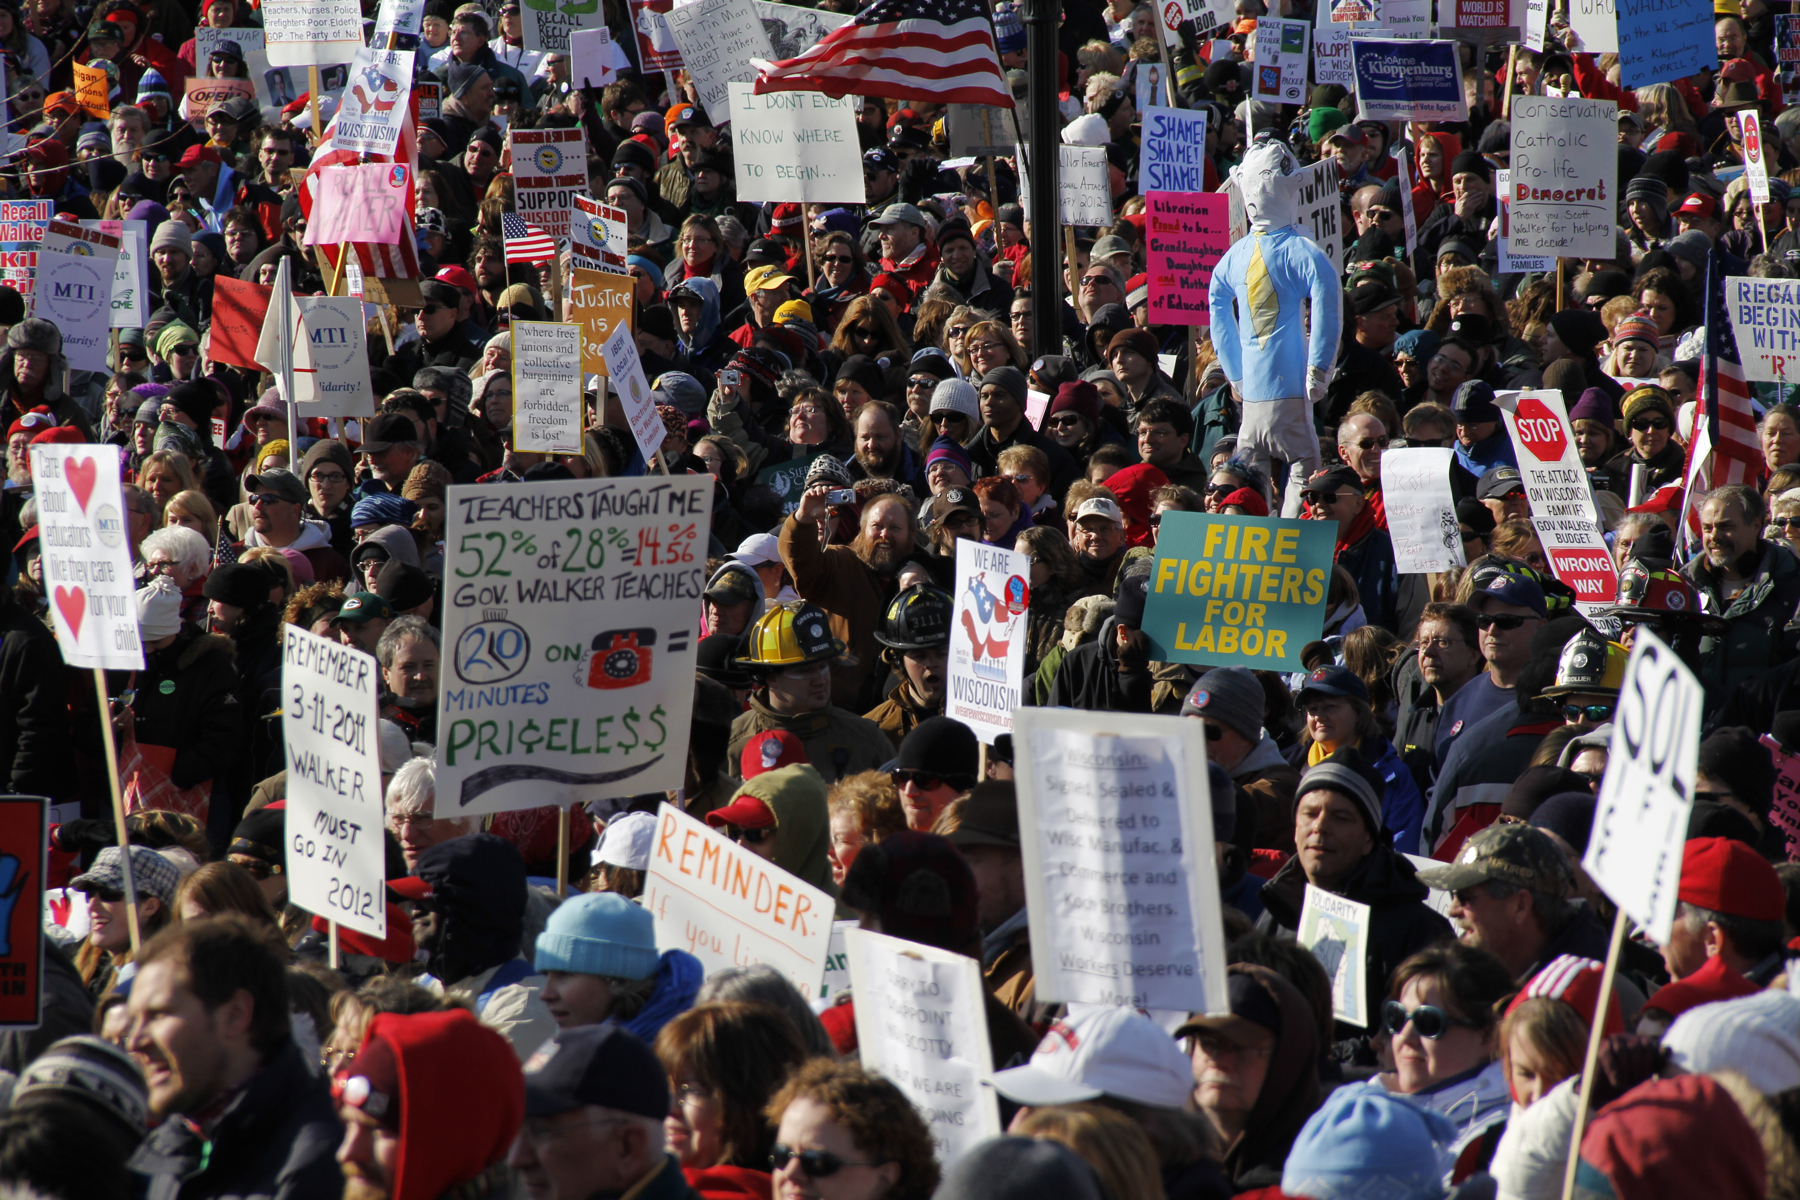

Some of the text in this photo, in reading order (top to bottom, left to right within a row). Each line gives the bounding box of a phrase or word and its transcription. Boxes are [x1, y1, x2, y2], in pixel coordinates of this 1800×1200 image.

[720, 8, 748, 24] Man
[1461, 1, 1493, 13] WORLD
[537, 12, 583, 27] RECALL
[1258, 20, 1281, 30] WALKER
[1388, 16, 1411, 24] Thank
[1459, 14, 1507, 26] WATCHING.
[236, 29, 260, 43] WAR
[306, 31, 328, 41] Party
[1619, 22, 1670, 45] on the WI
[371, 51, 402, 66] WE ARE
[1382, 53, 1416, 66] JoAnne
[1621, 43, 1699, 67] Vote Kloppenburg
[1368, 60, 1453, 79] Kloppenburg
[1632, 56, 1699, 81] on APRIL 5
[1281, 76, 1304, 86] PACKER
[741, 92, 756, 110] I
[1365, 101, 1434, 111] Elections Vote
[1513, 96, 1617, 123] Conservative
[338, 121, 398, 142] WISCONSIN
[740, 128, 844, 145] KNOW WHERE
[1150, 114, 1205, 145] SHAME!
[1514, 130, 1589, 149] Catholic
[1147, 138, 1199, 164] SHAME!
[516, 173, 586, 188] BUILDING TRADES
[742, 163, 764, 178] TO
[1148, 163, 1199, 192] SHAME!
[1516, 178, 1607, 203] Democrat
[1, 201, 48, 221] Recall
[1153, 200, 1209, 216] Librarian
[1513, 209, 1591, 220] Thank Scott
[1072, 215, 1105, 225] WALKER
[1152, 216, 1180, 232] Proud
[1182, 221, 1193, 233] to
[1311, 205, 1337, 242] THE
[1512, 222, 1610, 237] Walker for helping
[1514, 237, 1574, 248] me decide!
[1511, 260, 1545, 270] FAMILIES
[53, 281, 96, 301] MTI
[1152, 294, 1165, 310] of
[556, 327, 576, 339] free
[521, 342, 553, 353] unions
[555, 344, 574, 354] and
[610, 334, 626, 358] IBEW
[523, 357, 571, 369] collective
[612, 355, 630, 377] Local
[522, 369, 574, 384] bargaining
[539, 387, 555, 396] are
[523, 400, 573, 413] forbidden,
[528, 414, 568, 426] freedom
[1517, 417, 1560, 443] STOP
[531, 428, 540, 440] is
[636, 425, 645, 440] For
[643, 423, 661, 449] Families
[39, 450, 60, 479] Care
[1388, 457, 1435, 492] Scott
[1530, 469, 1581, 484] THE ATTACK
[42, 485, 68, 513] about
[459, 484, 705, 525] TEACHERS TAUGHT ME
[1530, 487, 1590, 502] ON WISCONSIN
[46, 520, 92, 548] educators
[98, 518, 120, 532] MTI
[1536, 520, 1558, 532] GOV.
[1203, 523, 1300, 563] FIRE
[1555, 533, 1593, 544] BUDGET:
[455, 526, 629, 578] 52% of 28%
[974, 547, 1010, 575] WE ARE
[51, 553, 115, 586] like they care
[1555, 556, 1611, 573] WRONG
[454, 568, 702, 607] GOV. WALKER TEACHES
[1154, 557, 1325, 605] FIGHTERS
[1573, 578, 1604, 594] WAY
[88, 589, 128, 620] for your
[1203, 599, 1267, 627] FOR
[115, 623, 139, 651] child
[1174, 622, 1287, 658] LABOR
[463, 626, 583, 672] 20 ON
[285, 632, 368, 693] REMEMBER
[445, 682, 550, 713] MINUTES
[952, 674, 1019, 712] WISCONSIN
[290, 684, 367, 757] 3-11-2011
[954, 703, 1014, 732] wearewisconsin.org
[1066, 748, 1149, 769] Wisconsin:
[288, 742, 365, 802] WALKER
[1099, 780, 1156, 799] Sealed
[314, 809, 362, 845] MUST
[1066, 809, 1160, 830] Delivered to
[294, 834, 348, 869] GO IN
[657, 811, 819, 937] REMINDER:
[1059, 861, 1178, 885] Commerce and
[1099, 899, 1178, 917] Brothers.
[1310, 890, 1358, 920] SOLIDARITY
[686, 919, 724, 955] you
[1082, 924, 1160, 945] Wisconsin
[1060, 951, 1194, 978] Workers Deserve
[1098, 990, 1148, 1008] More!
[911, 1073, 963, 1098] WE ARE
